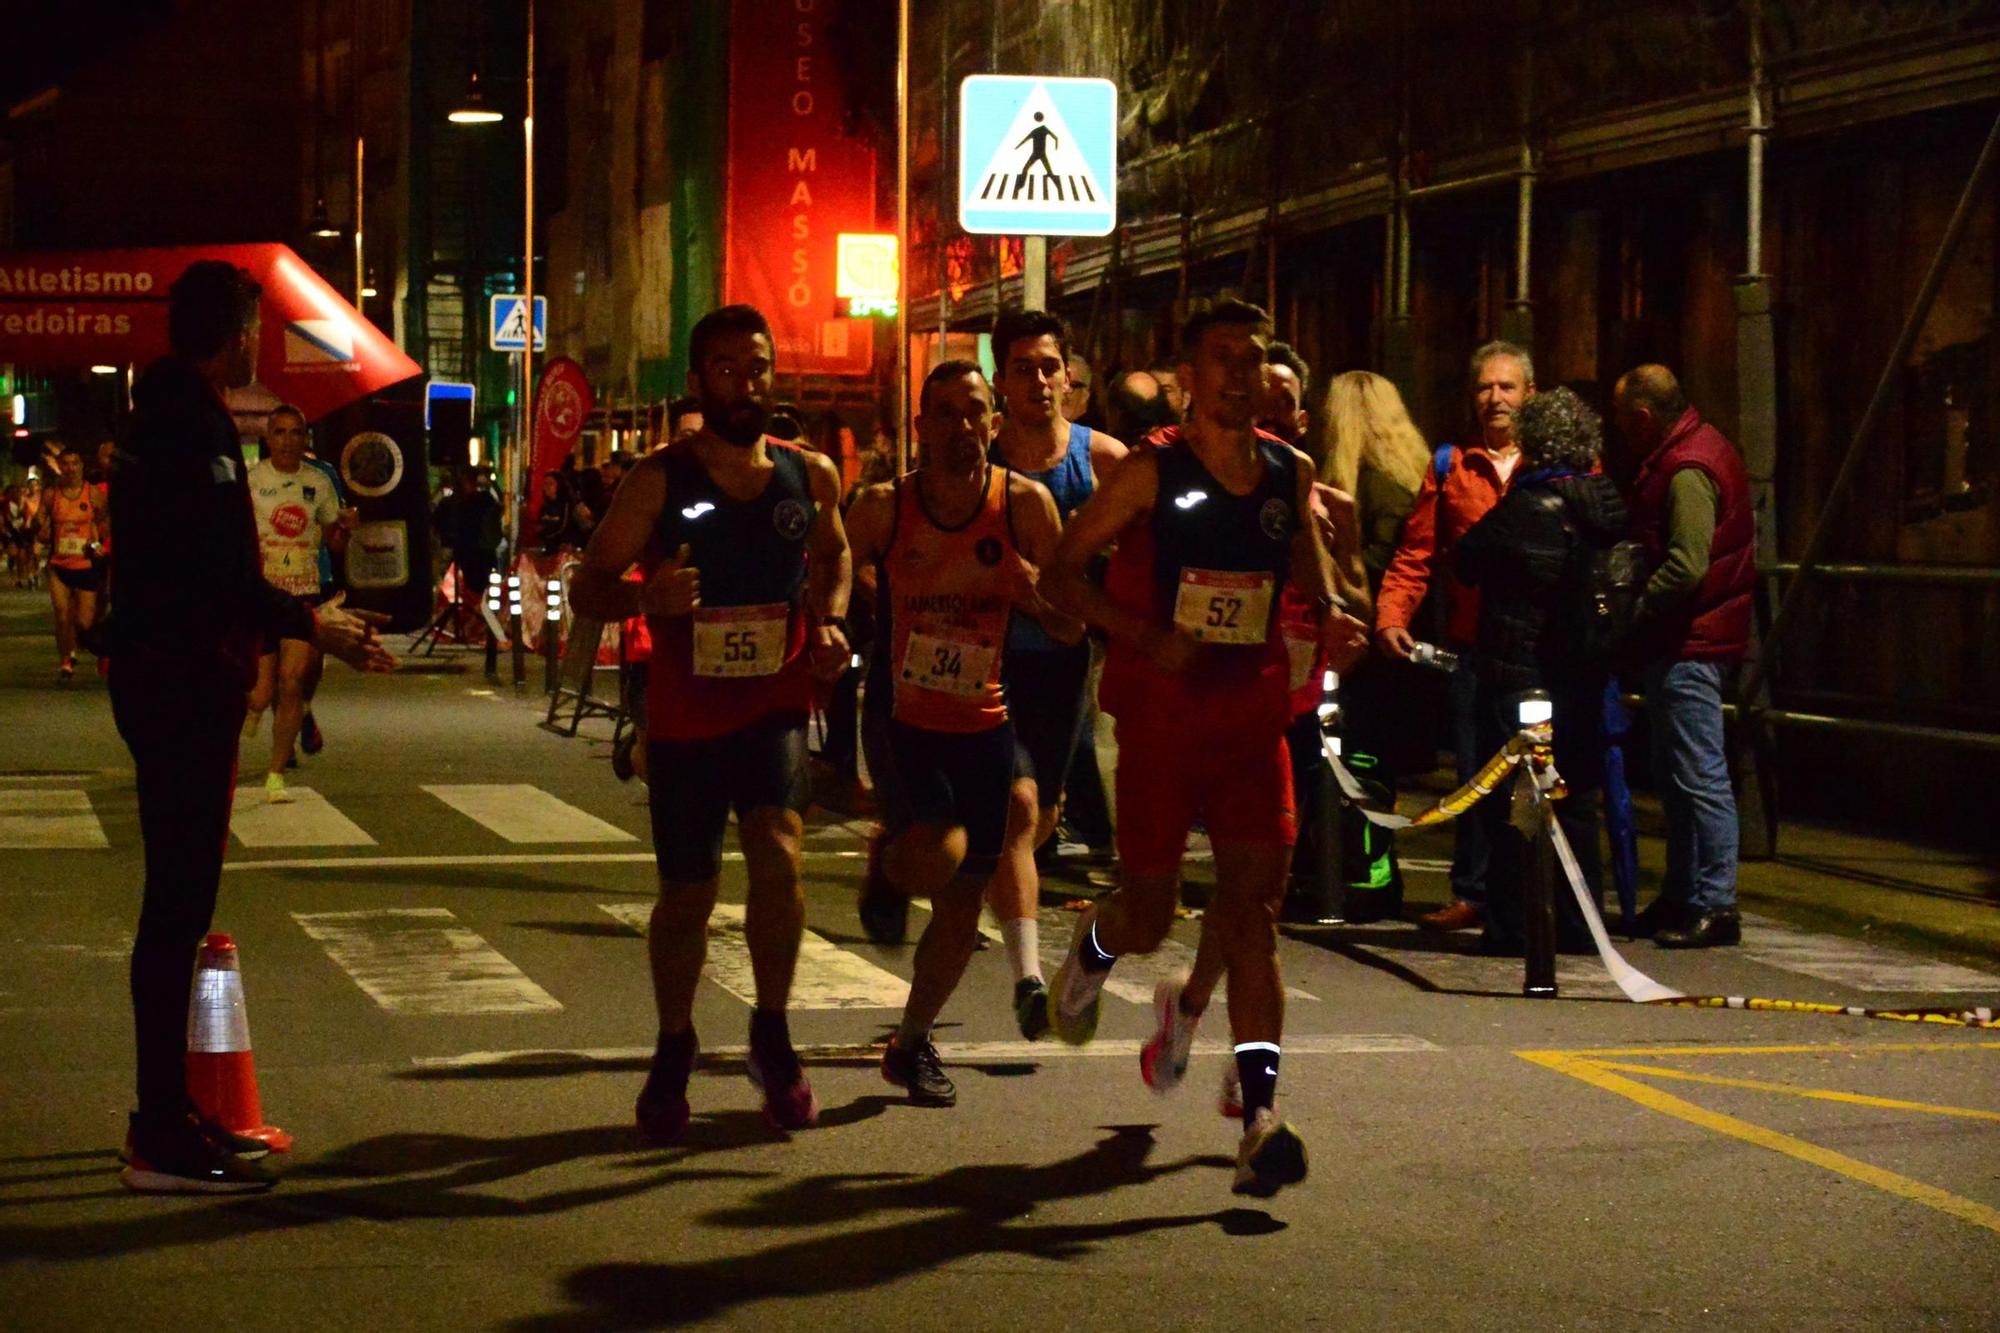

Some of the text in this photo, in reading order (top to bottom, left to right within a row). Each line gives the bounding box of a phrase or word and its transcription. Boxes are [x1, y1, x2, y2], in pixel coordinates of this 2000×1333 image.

[787, 146, 817, 308] MASSÓ
[0, 305, 132, 335] edoiras
[1206, 596, 1242, 628] 52
[724, 630, 757, 662] 55
[931, 646, 961, 679] 34
